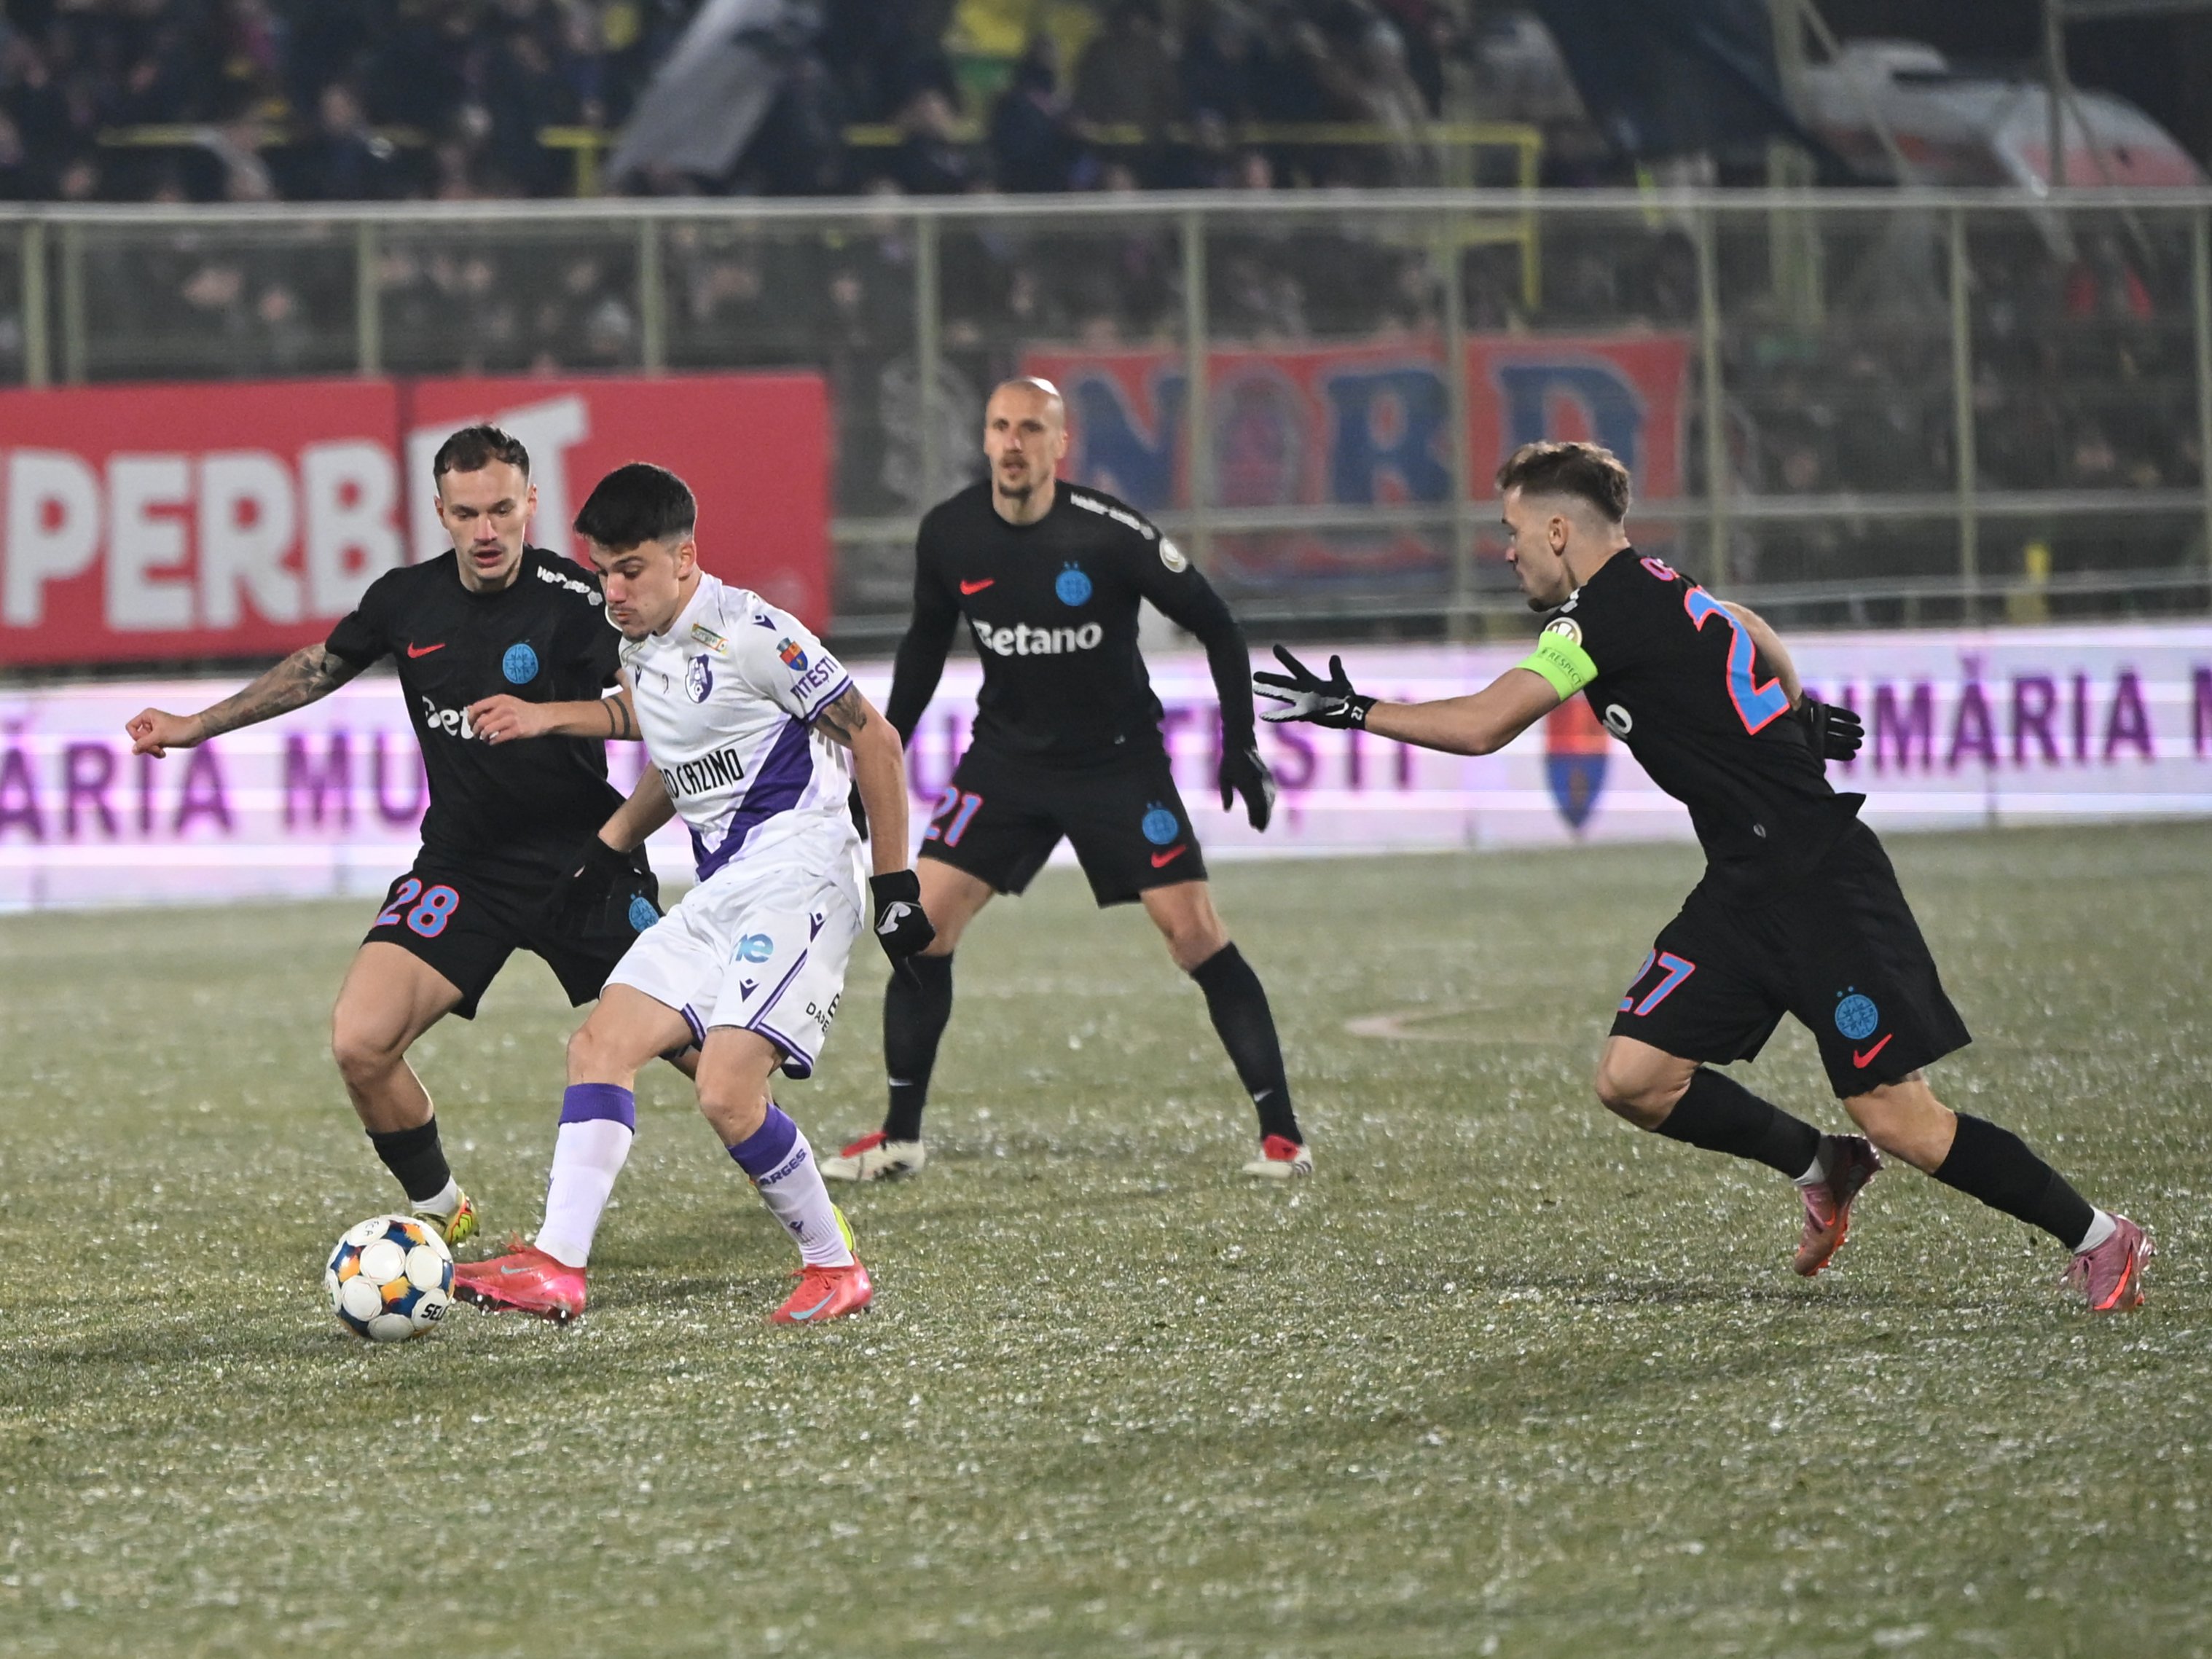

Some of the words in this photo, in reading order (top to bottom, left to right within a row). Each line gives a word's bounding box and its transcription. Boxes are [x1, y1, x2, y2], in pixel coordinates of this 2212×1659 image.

[1064, 363, 1648, 543] NORD
[972, 620, 1103, 656] Betano
[1548, 651, 1582, 685] RESPECT
[1350, 705, 1365, 721] 27
[1804, 647, 2157, 775] IMĂRIA
[676, 749, 745, 795] CAZINO
[924, 785, 983, 833] 21
[373, 878, 460, 938] 28
